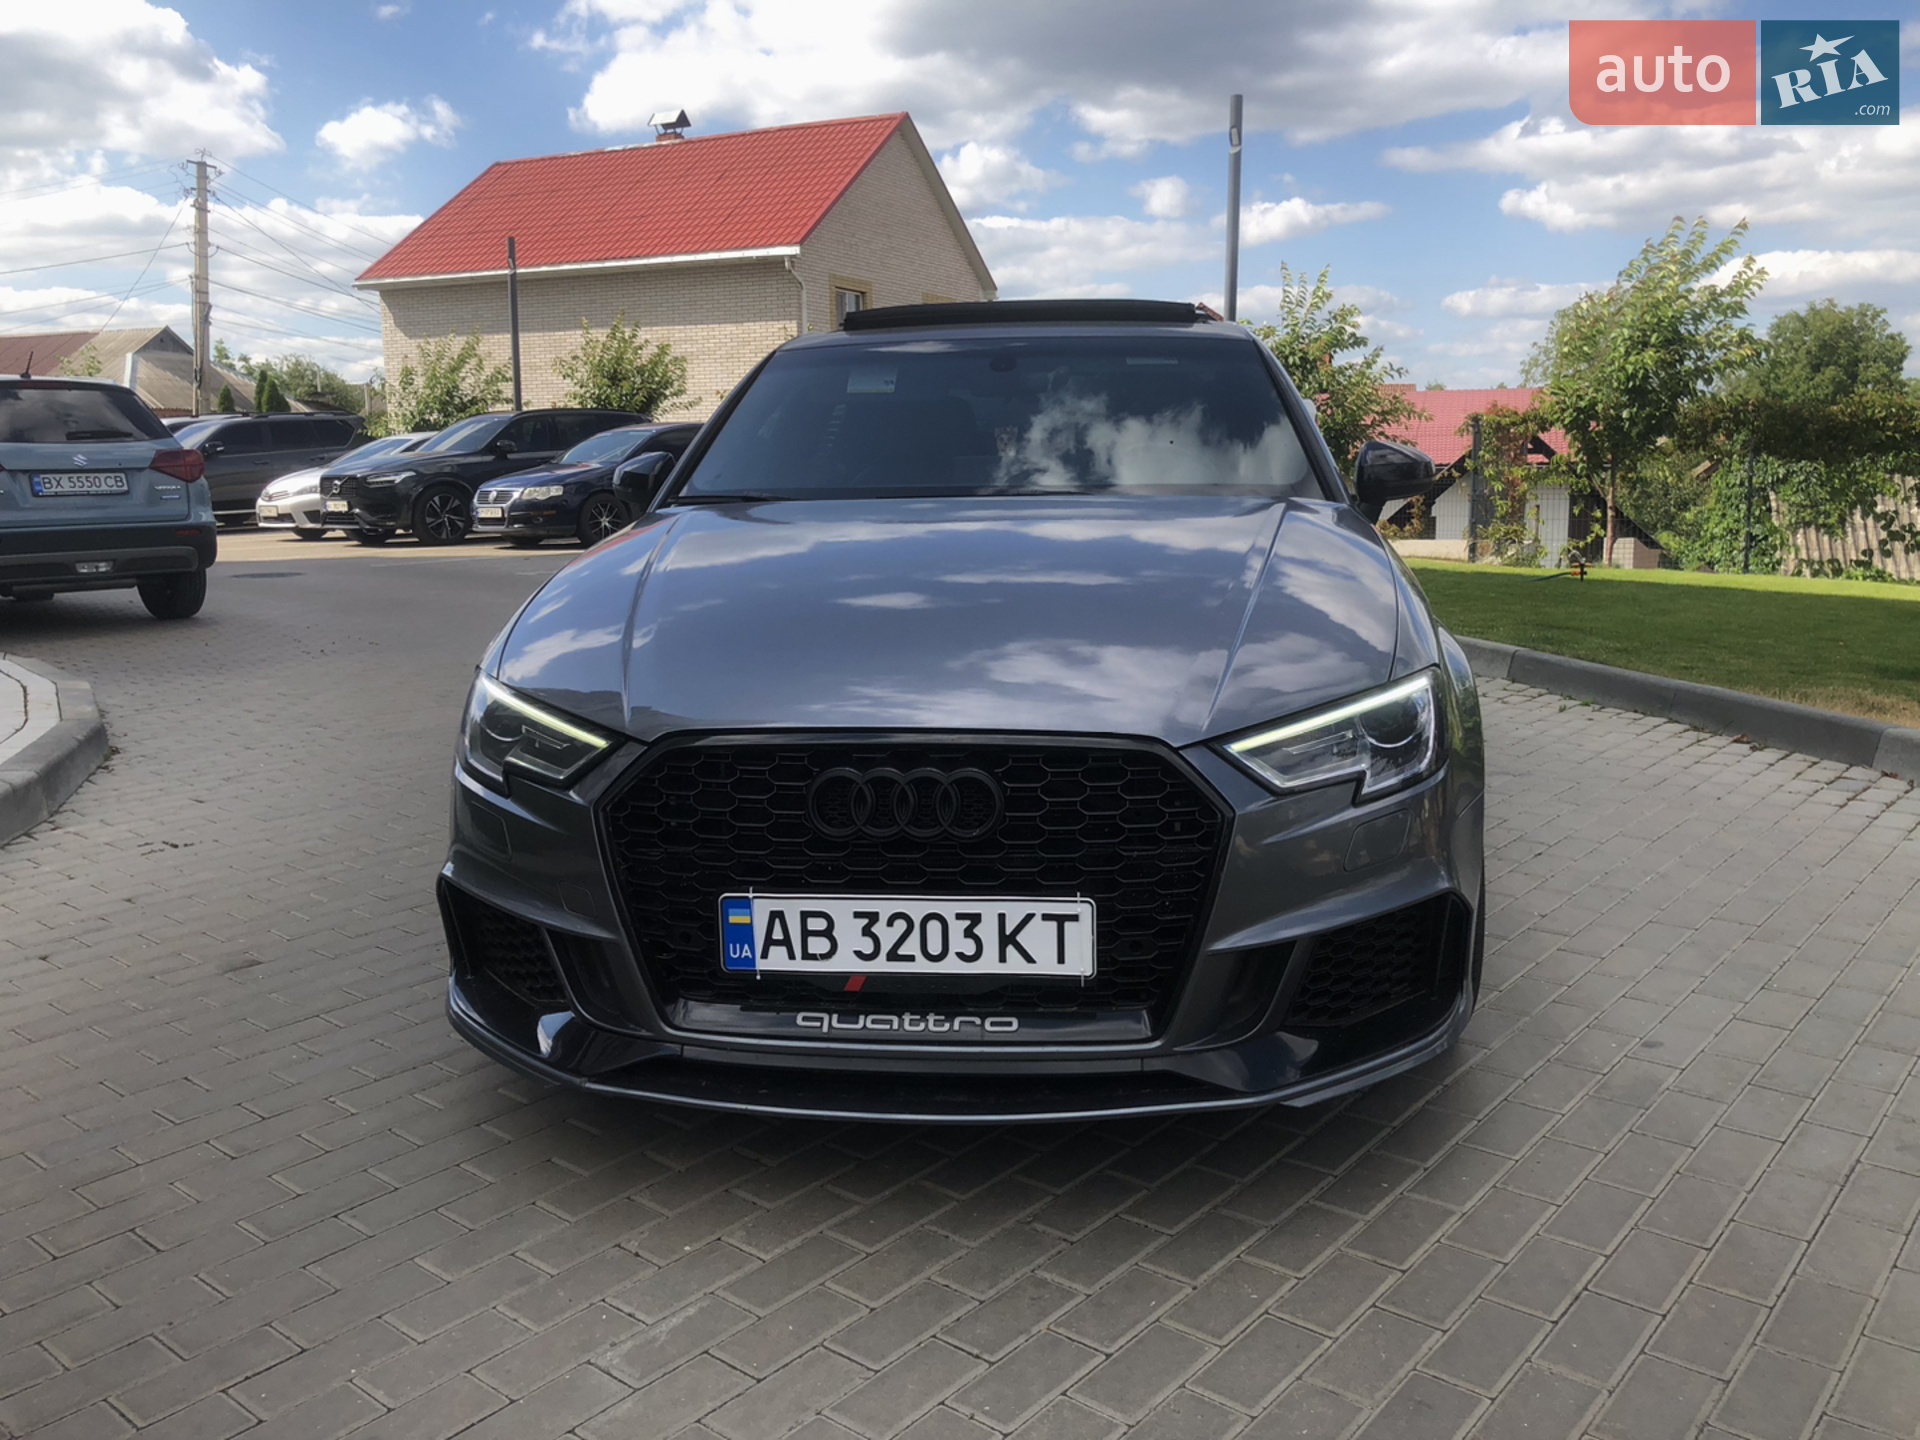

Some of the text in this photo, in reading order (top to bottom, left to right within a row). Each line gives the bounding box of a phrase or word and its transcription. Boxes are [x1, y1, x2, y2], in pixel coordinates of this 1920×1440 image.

[42, 476, 64, 490] BX
[68, 476, 102, 489] 5550
[104, 475, 125, 488] CB
[760, 910, 1080, 964] AB 3203 KT
[729, 943, 753, 959] UA
[796, 1011, 1019, 1033] quattro
